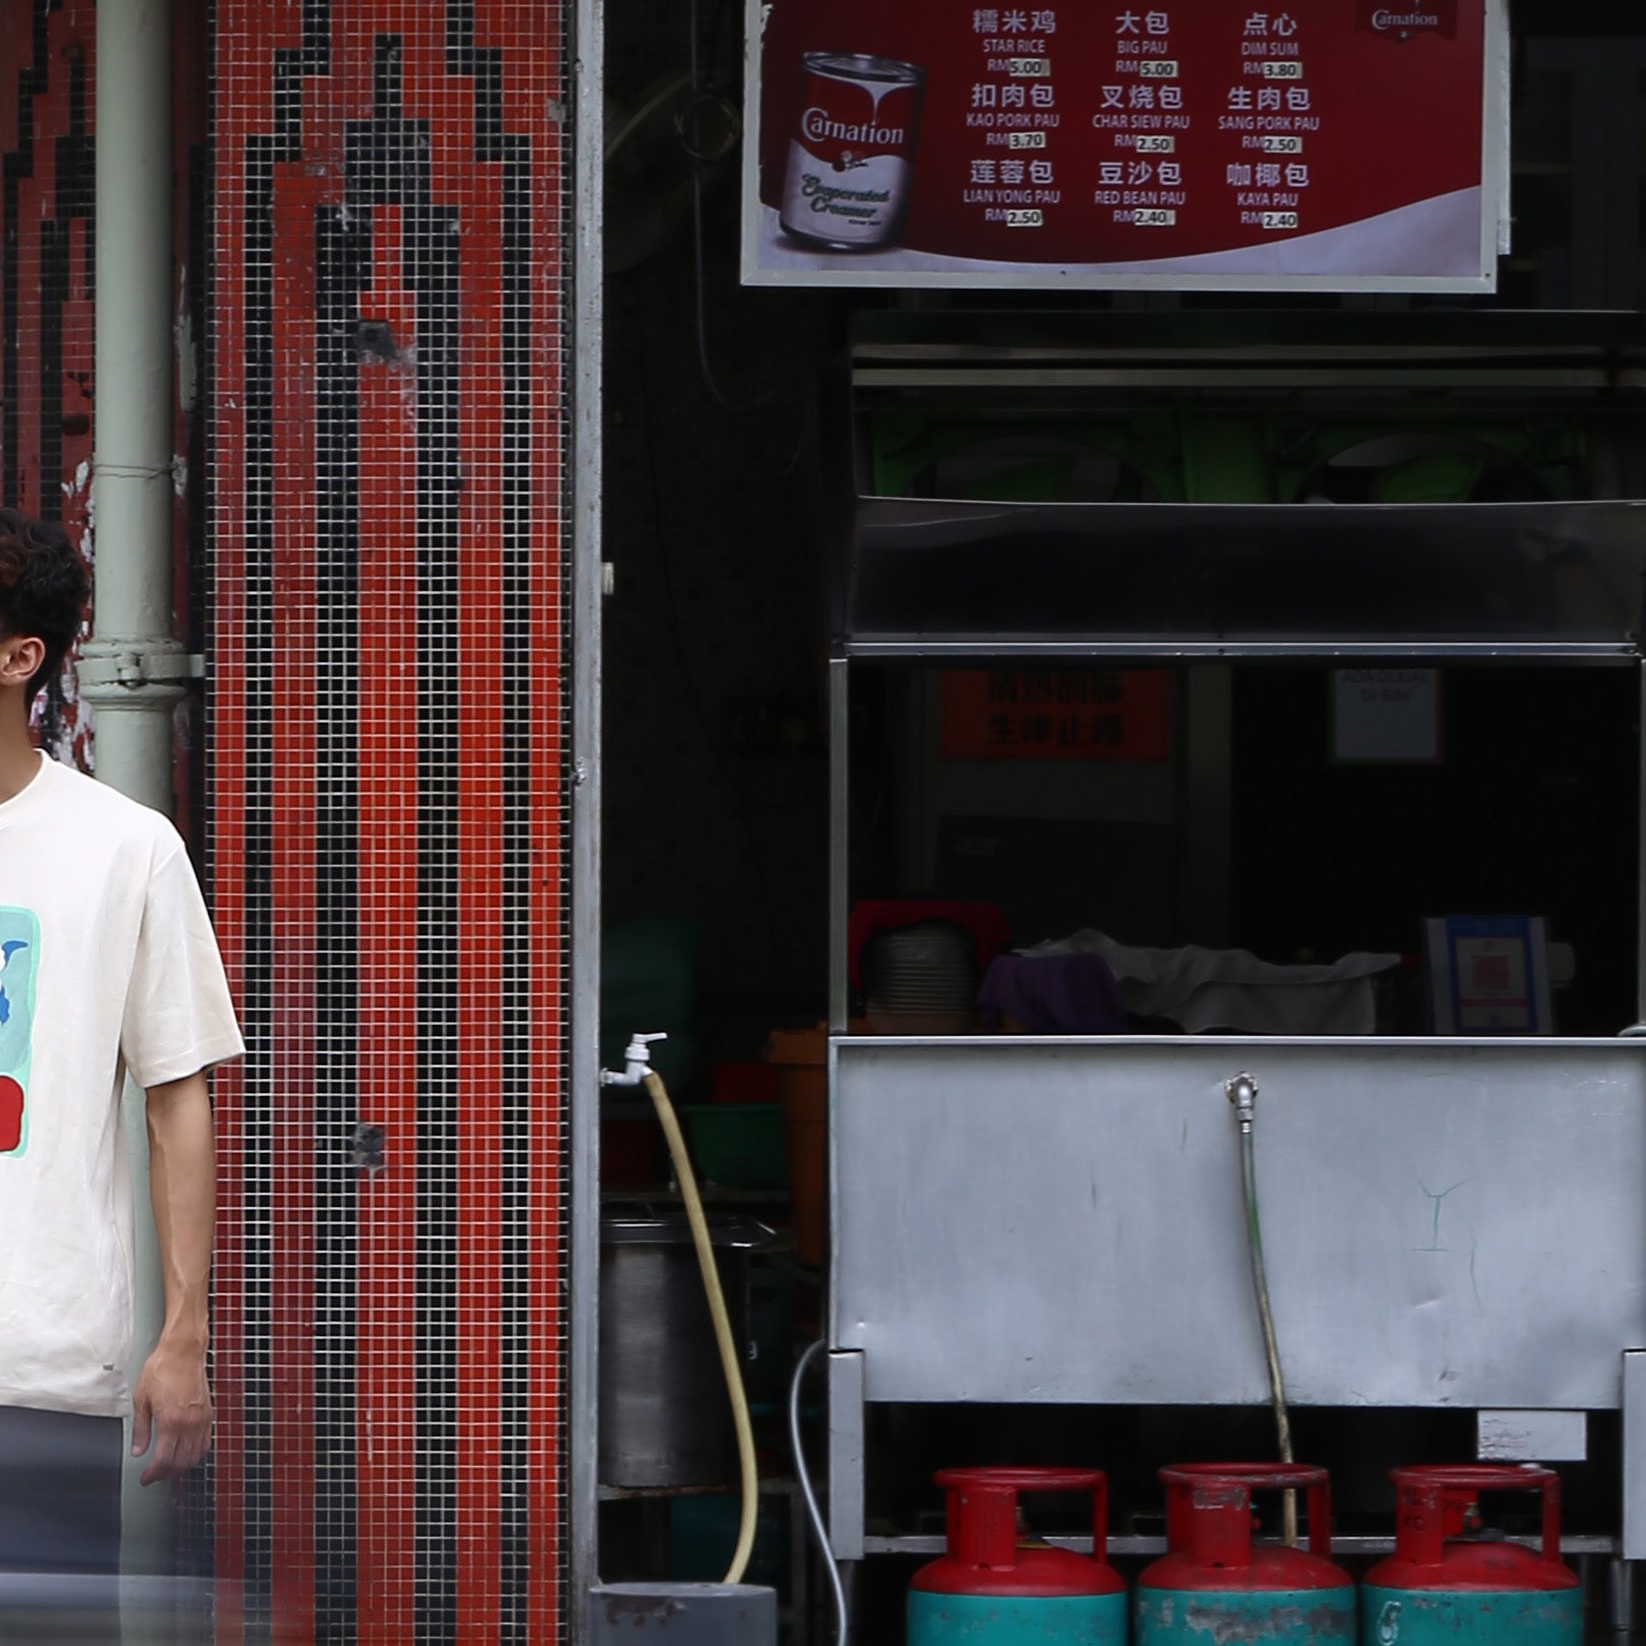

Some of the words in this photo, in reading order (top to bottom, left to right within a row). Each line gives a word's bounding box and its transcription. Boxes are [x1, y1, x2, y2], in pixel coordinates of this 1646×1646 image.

[971, 9, 1057, 34] 糯米鸡
[1115, 10, 1170, 35] 大包
[1242, 12, 1298, 37] 点心
[1371, 9, 1438, 30] Carnation
[982, 39, 1015, 54] STAR
[1017, 39, 1046, 54] RICE
[1117, 40, 1139, 54] BIG
[1141, 41, 1168, 55] PAU
[1240, 42, 1267, 56] DIM
[1269, 42, 1299, 56] SUM
[971, 83, 1055, 108] 扣肉包
[1100, 84, 1183, 109] 叉烧包
[1227, 86, 1311, 111] 生肉包
[801, 107, 905, 144] Carnation
[966, 113, 994, 127] KAO
[996, 113, 1032, 127] PORK
[1034, 113, 1060, 128] PAU
[1092, 114, 1128, 128] CHAR
[1130, 115, 1162, 129] SIEW
[1164, 115, 1190, 130] PAU
[1218, 116, 1254, 130] SANG
[1256, 117, 1292, 131] PORK
[1294, 117, 1321, 131] PAU
[970, 159, 1054, 184] 莲蓉包
[1098, 161, 1181, 186] 豆沙包
[1226, 162, 1309, 187] 咖椰包
[963, 190, 993, 203] LIAN
[995, 190, 1033, 203] YONG
[1035, 190, 1061, 204] PAU
[1094, 191, 1120, 204] RED
[1122, 191, 1157, 205] BEAN
[1159, 192, 1186, 205] PAU
[1237, 193, 1270, 206] KAYA
[1272, 193, 1299, 206] PAU
